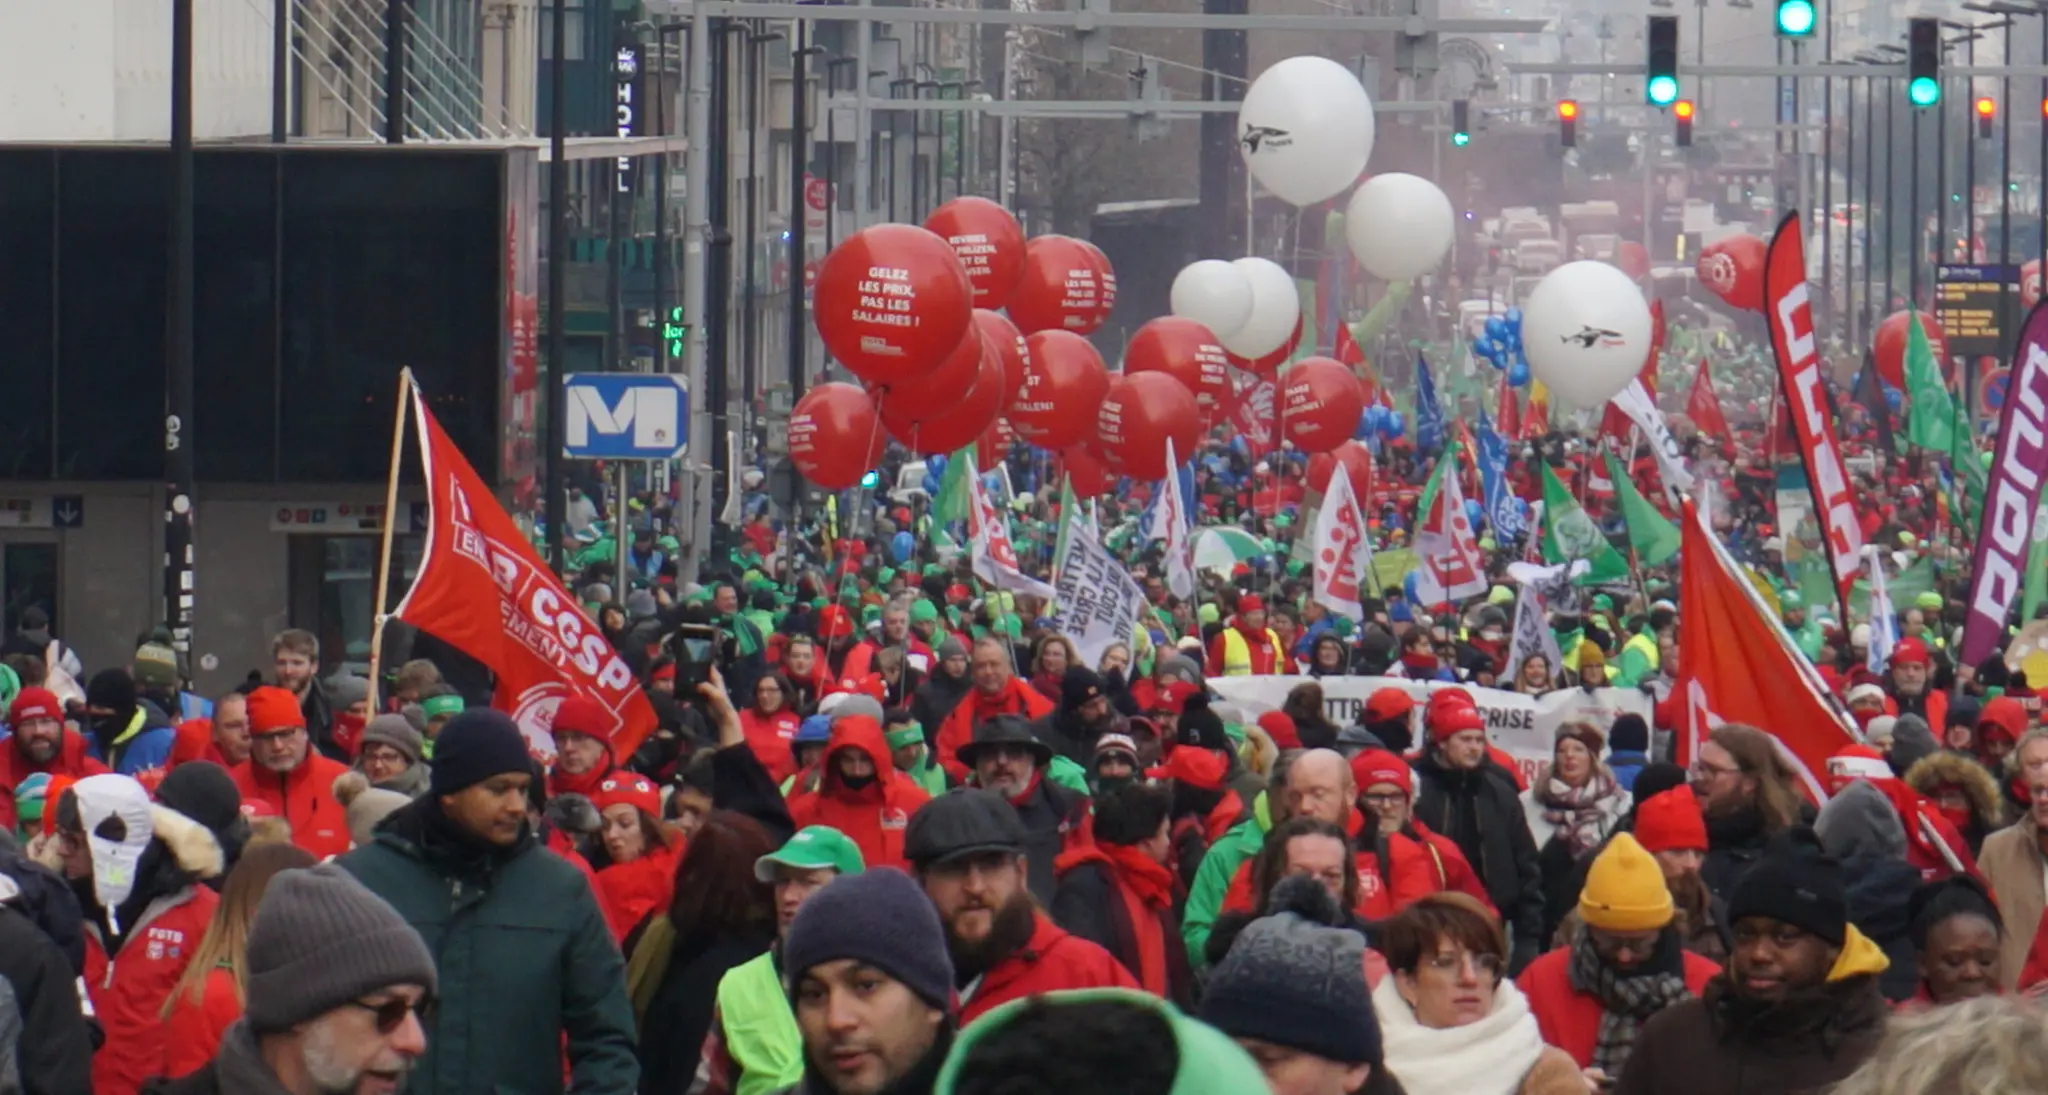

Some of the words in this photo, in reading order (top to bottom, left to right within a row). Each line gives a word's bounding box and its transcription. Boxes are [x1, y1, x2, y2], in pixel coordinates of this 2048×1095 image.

[869, 267, 908, 280] GELEZ
[859, 281, 879, 293] LES
[883, 283, 915, 298] PRIX,
[861, 295, 883, 308] PAS
[888, 299, 910, 311] LES
[852, 309, 910, 326] SALAIRES
[531, 587, 632, 690] CGSP
